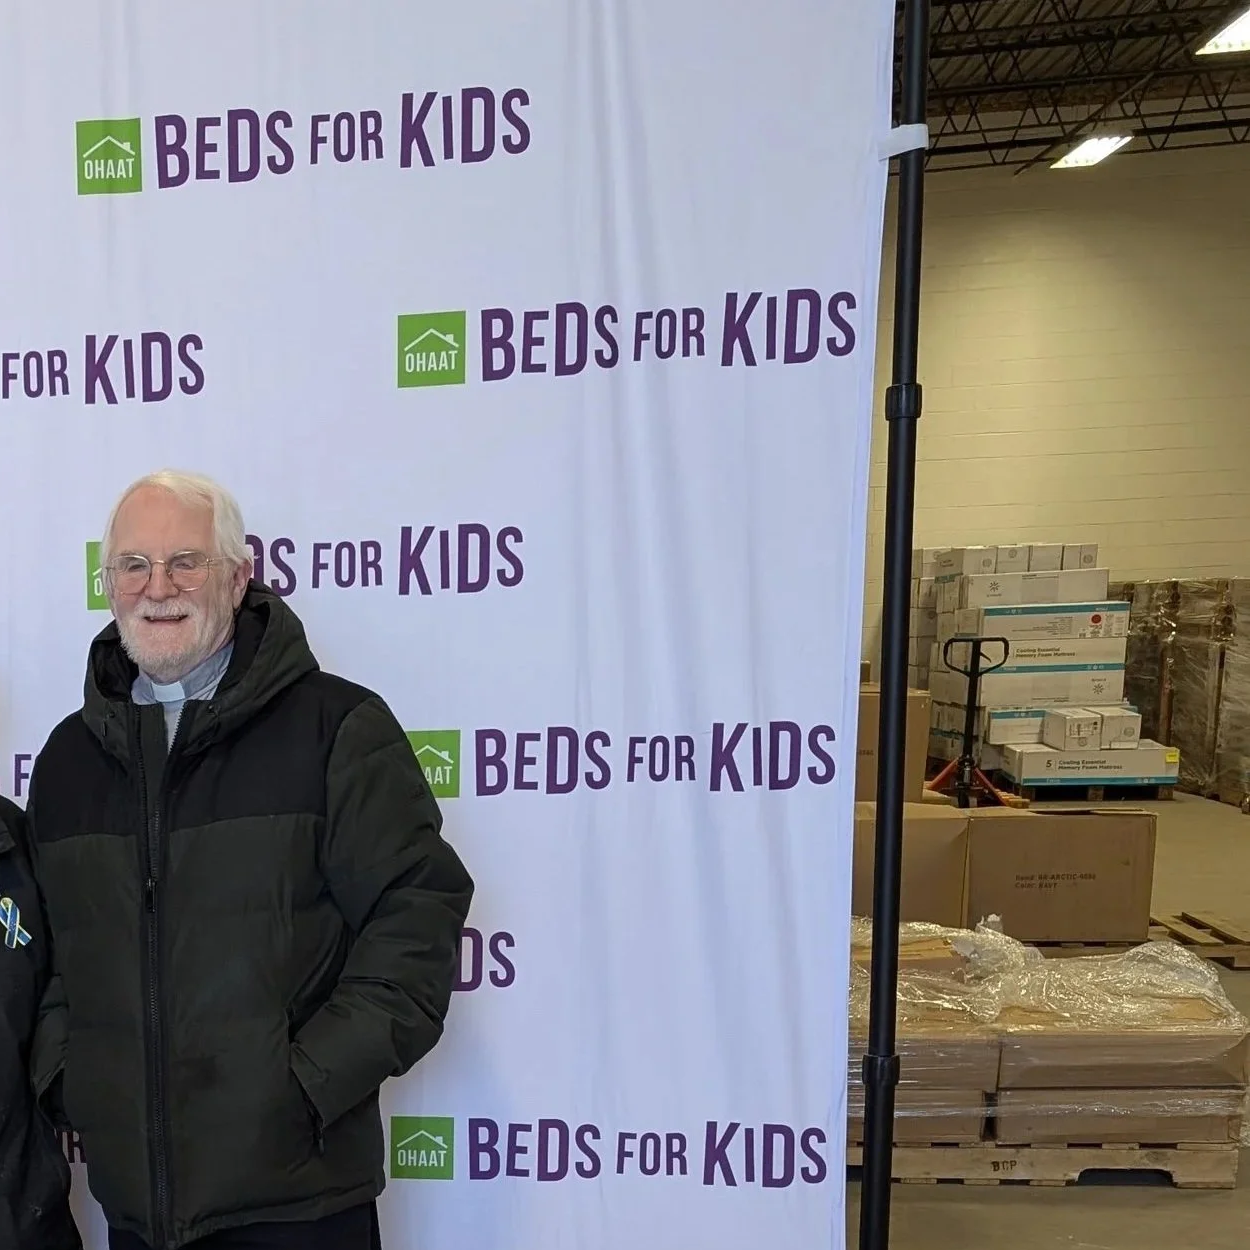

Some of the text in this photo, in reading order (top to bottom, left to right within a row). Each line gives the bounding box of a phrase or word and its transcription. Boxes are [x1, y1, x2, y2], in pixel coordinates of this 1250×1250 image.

[85, 159, 134, 179] OHAAT
[155, 87, 530, 188] BEDS FOR KIDS
[3, 350, 69, 399] FOR
[85, 332, 204, 404] KIDS
[406, 351, 457, 372] OHAAT
[481, 289, 856, 381] BEDS FOR KIDS
[312, 541, 382, 588] FOR
[399, 524, 523, 595] KIDS
[424, 766, 453, 784] AAT
[475, 721, 835, 796] BEDS FOR KIDS
[453, 928, 516, 992] DS
[399, 1150, 446, 1166] OHAAT
[469, 1118, 826, 1188] BEDS FOR KIDS
